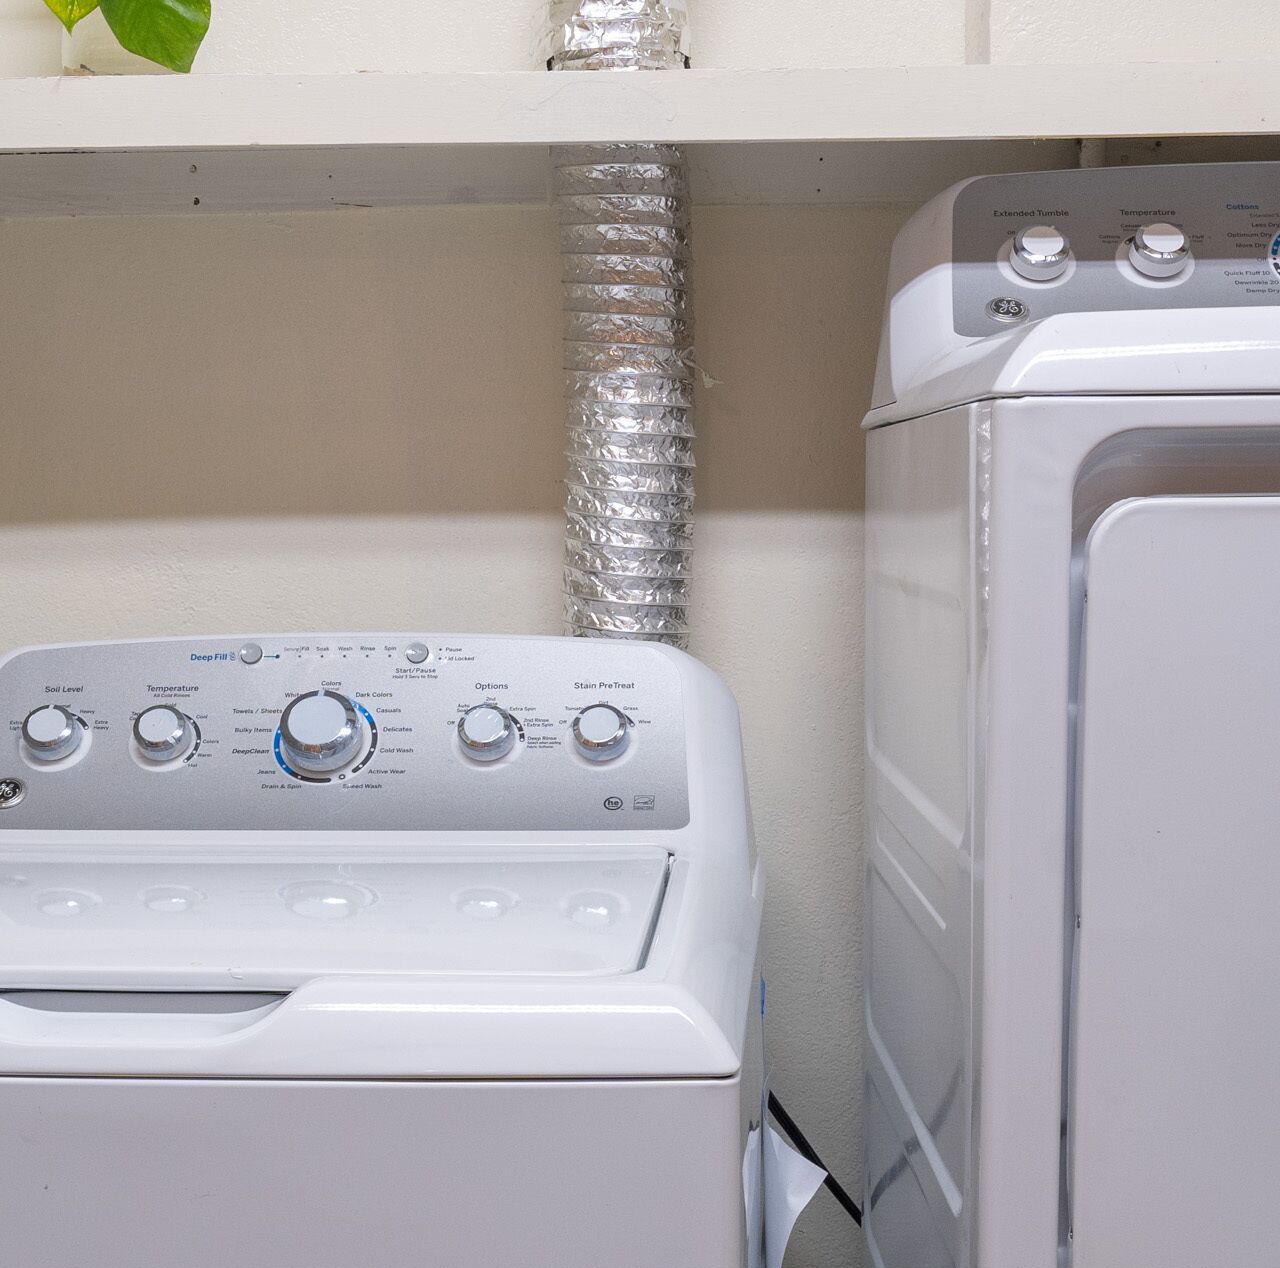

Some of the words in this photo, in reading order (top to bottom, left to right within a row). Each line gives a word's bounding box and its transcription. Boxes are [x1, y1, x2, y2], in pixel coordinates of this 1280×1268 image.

[190, 653, 213, 662] Deep
[146, 684, 199, 693] Temperature
[474, 682, 509, 691] Options
